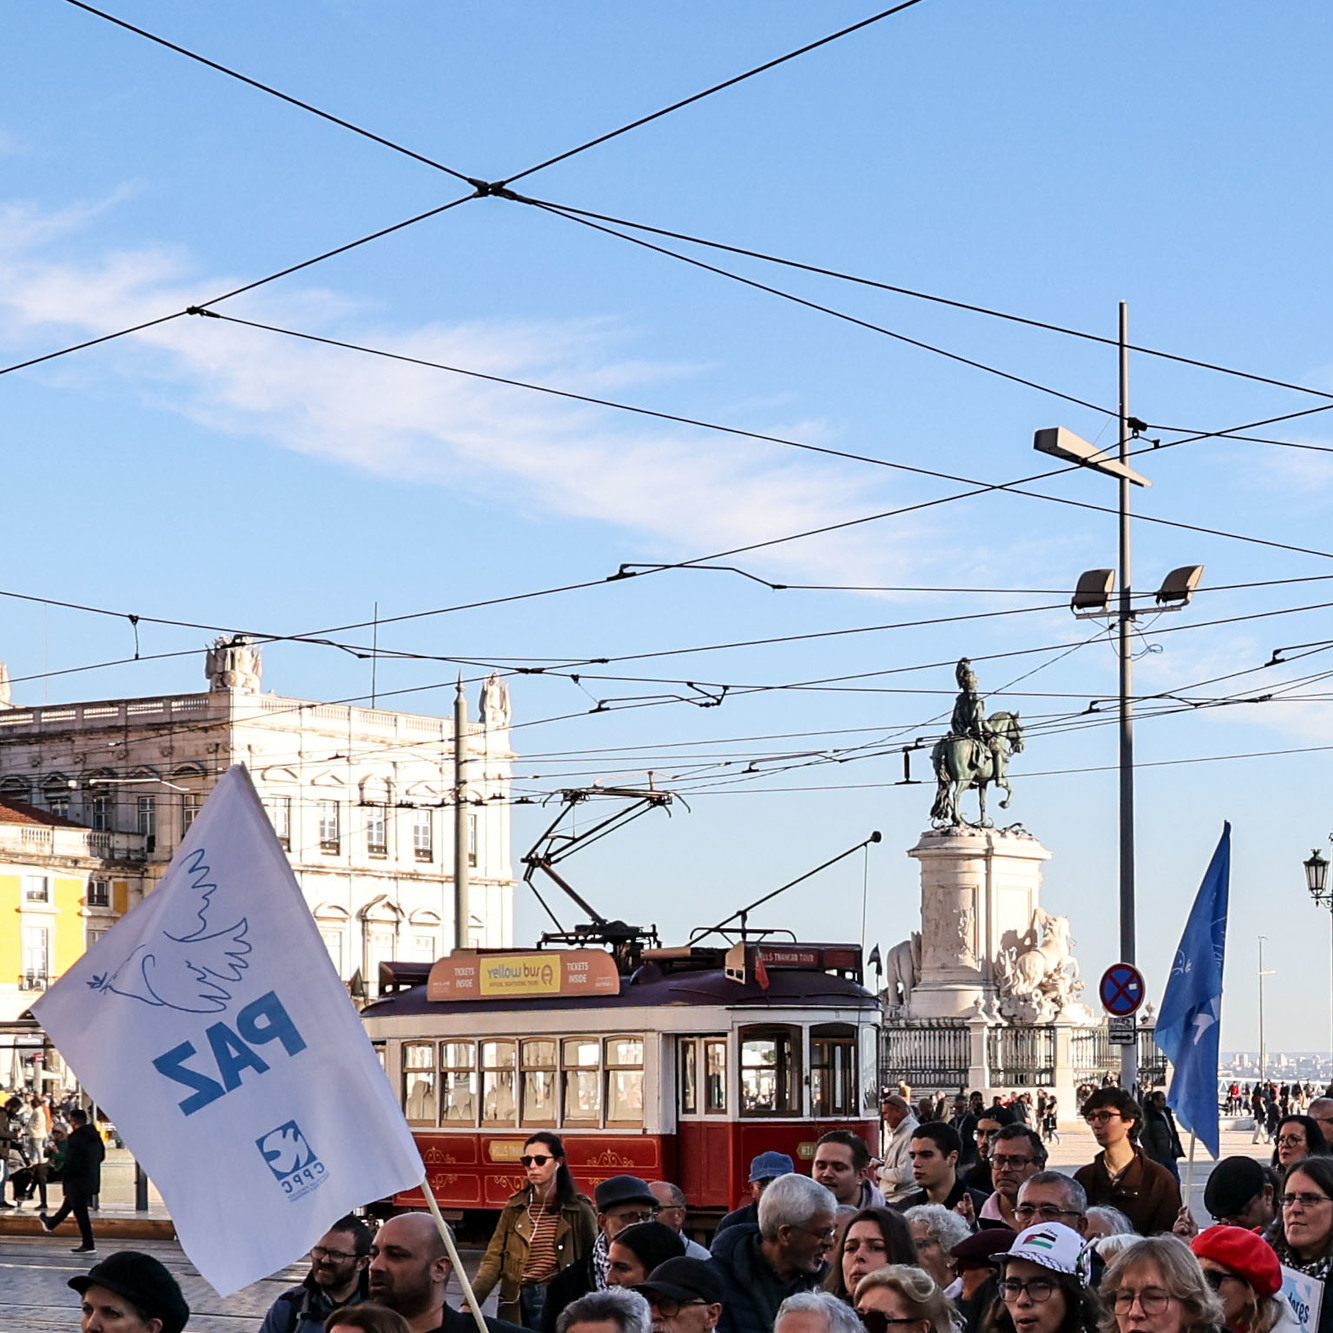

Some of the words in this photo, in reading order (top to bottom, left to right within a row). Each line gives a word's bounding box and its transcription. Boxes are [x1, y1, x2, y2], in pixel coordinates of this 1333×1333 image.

[454, 967, 475, 977] TICKETS
[523, 962, 540, 978] bus
[567, 962, 589, 972] TICKETS
